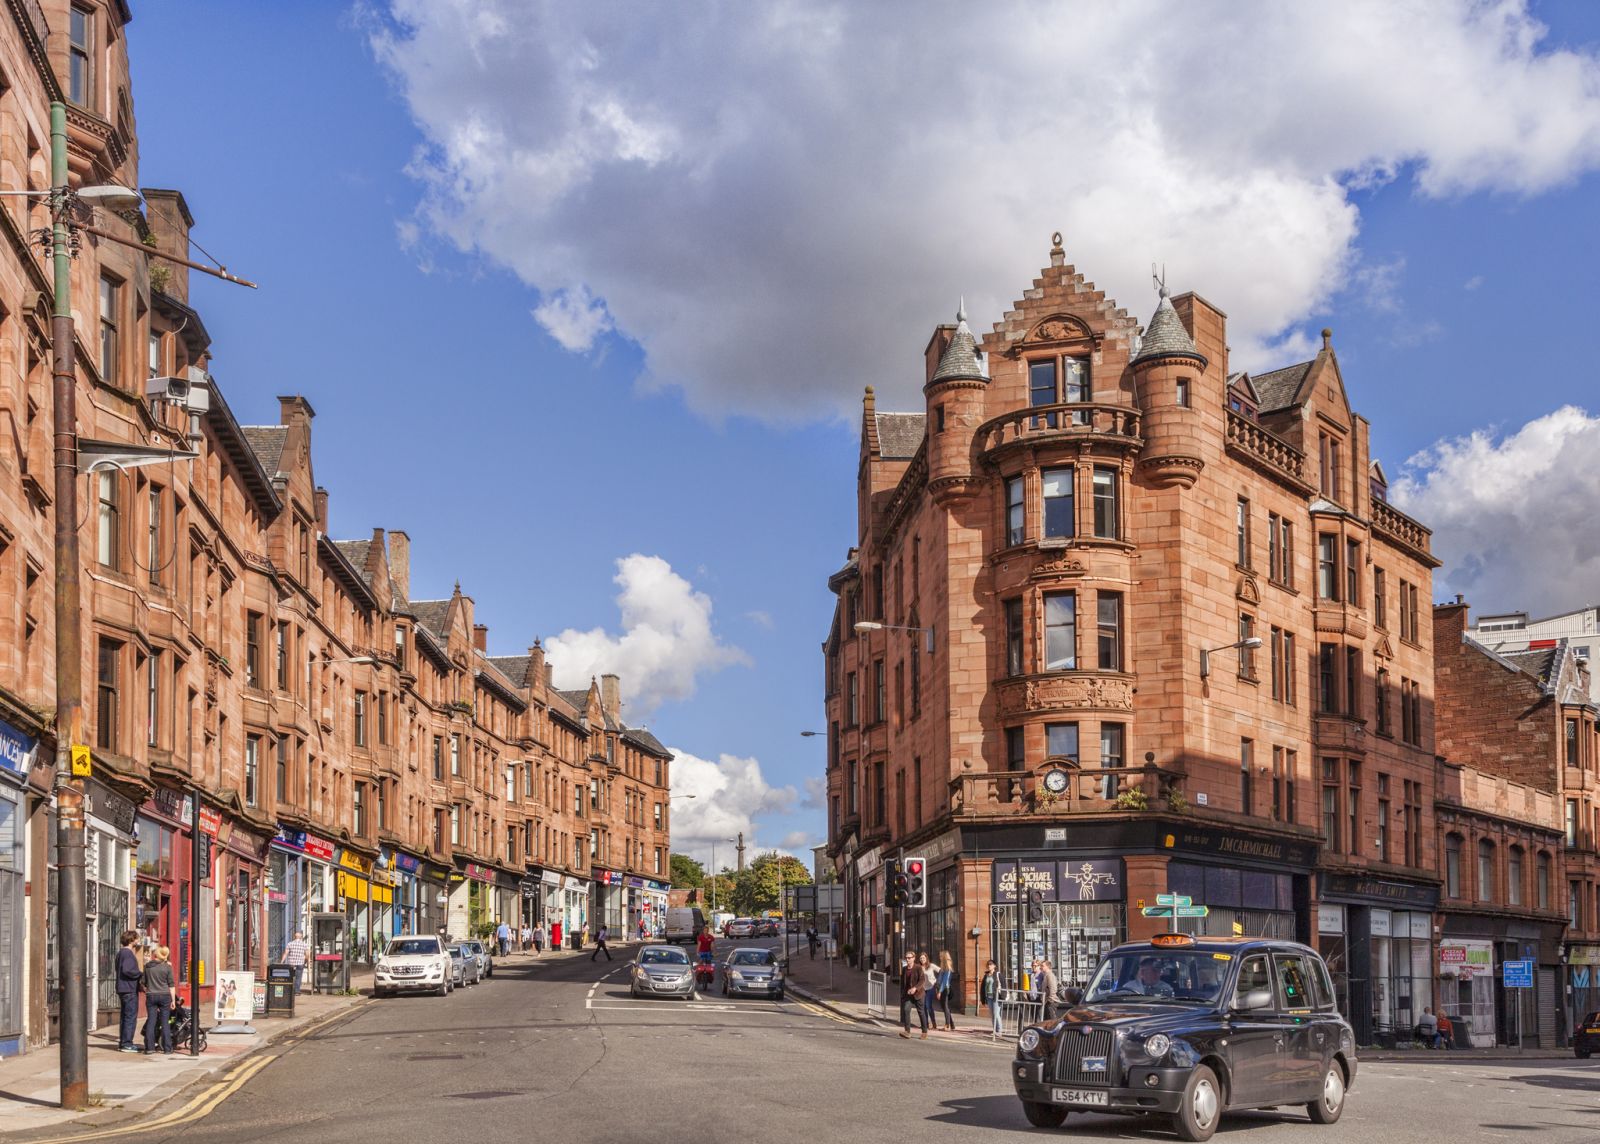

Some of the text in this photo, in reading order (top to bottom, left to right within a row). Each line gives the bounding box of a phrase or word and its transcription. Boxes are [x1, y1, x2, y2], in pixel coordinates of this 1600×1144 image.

[1159, 936, 1184, 945] TAXI
[1056, 1090, 1103, 1103] LS64 KTV
